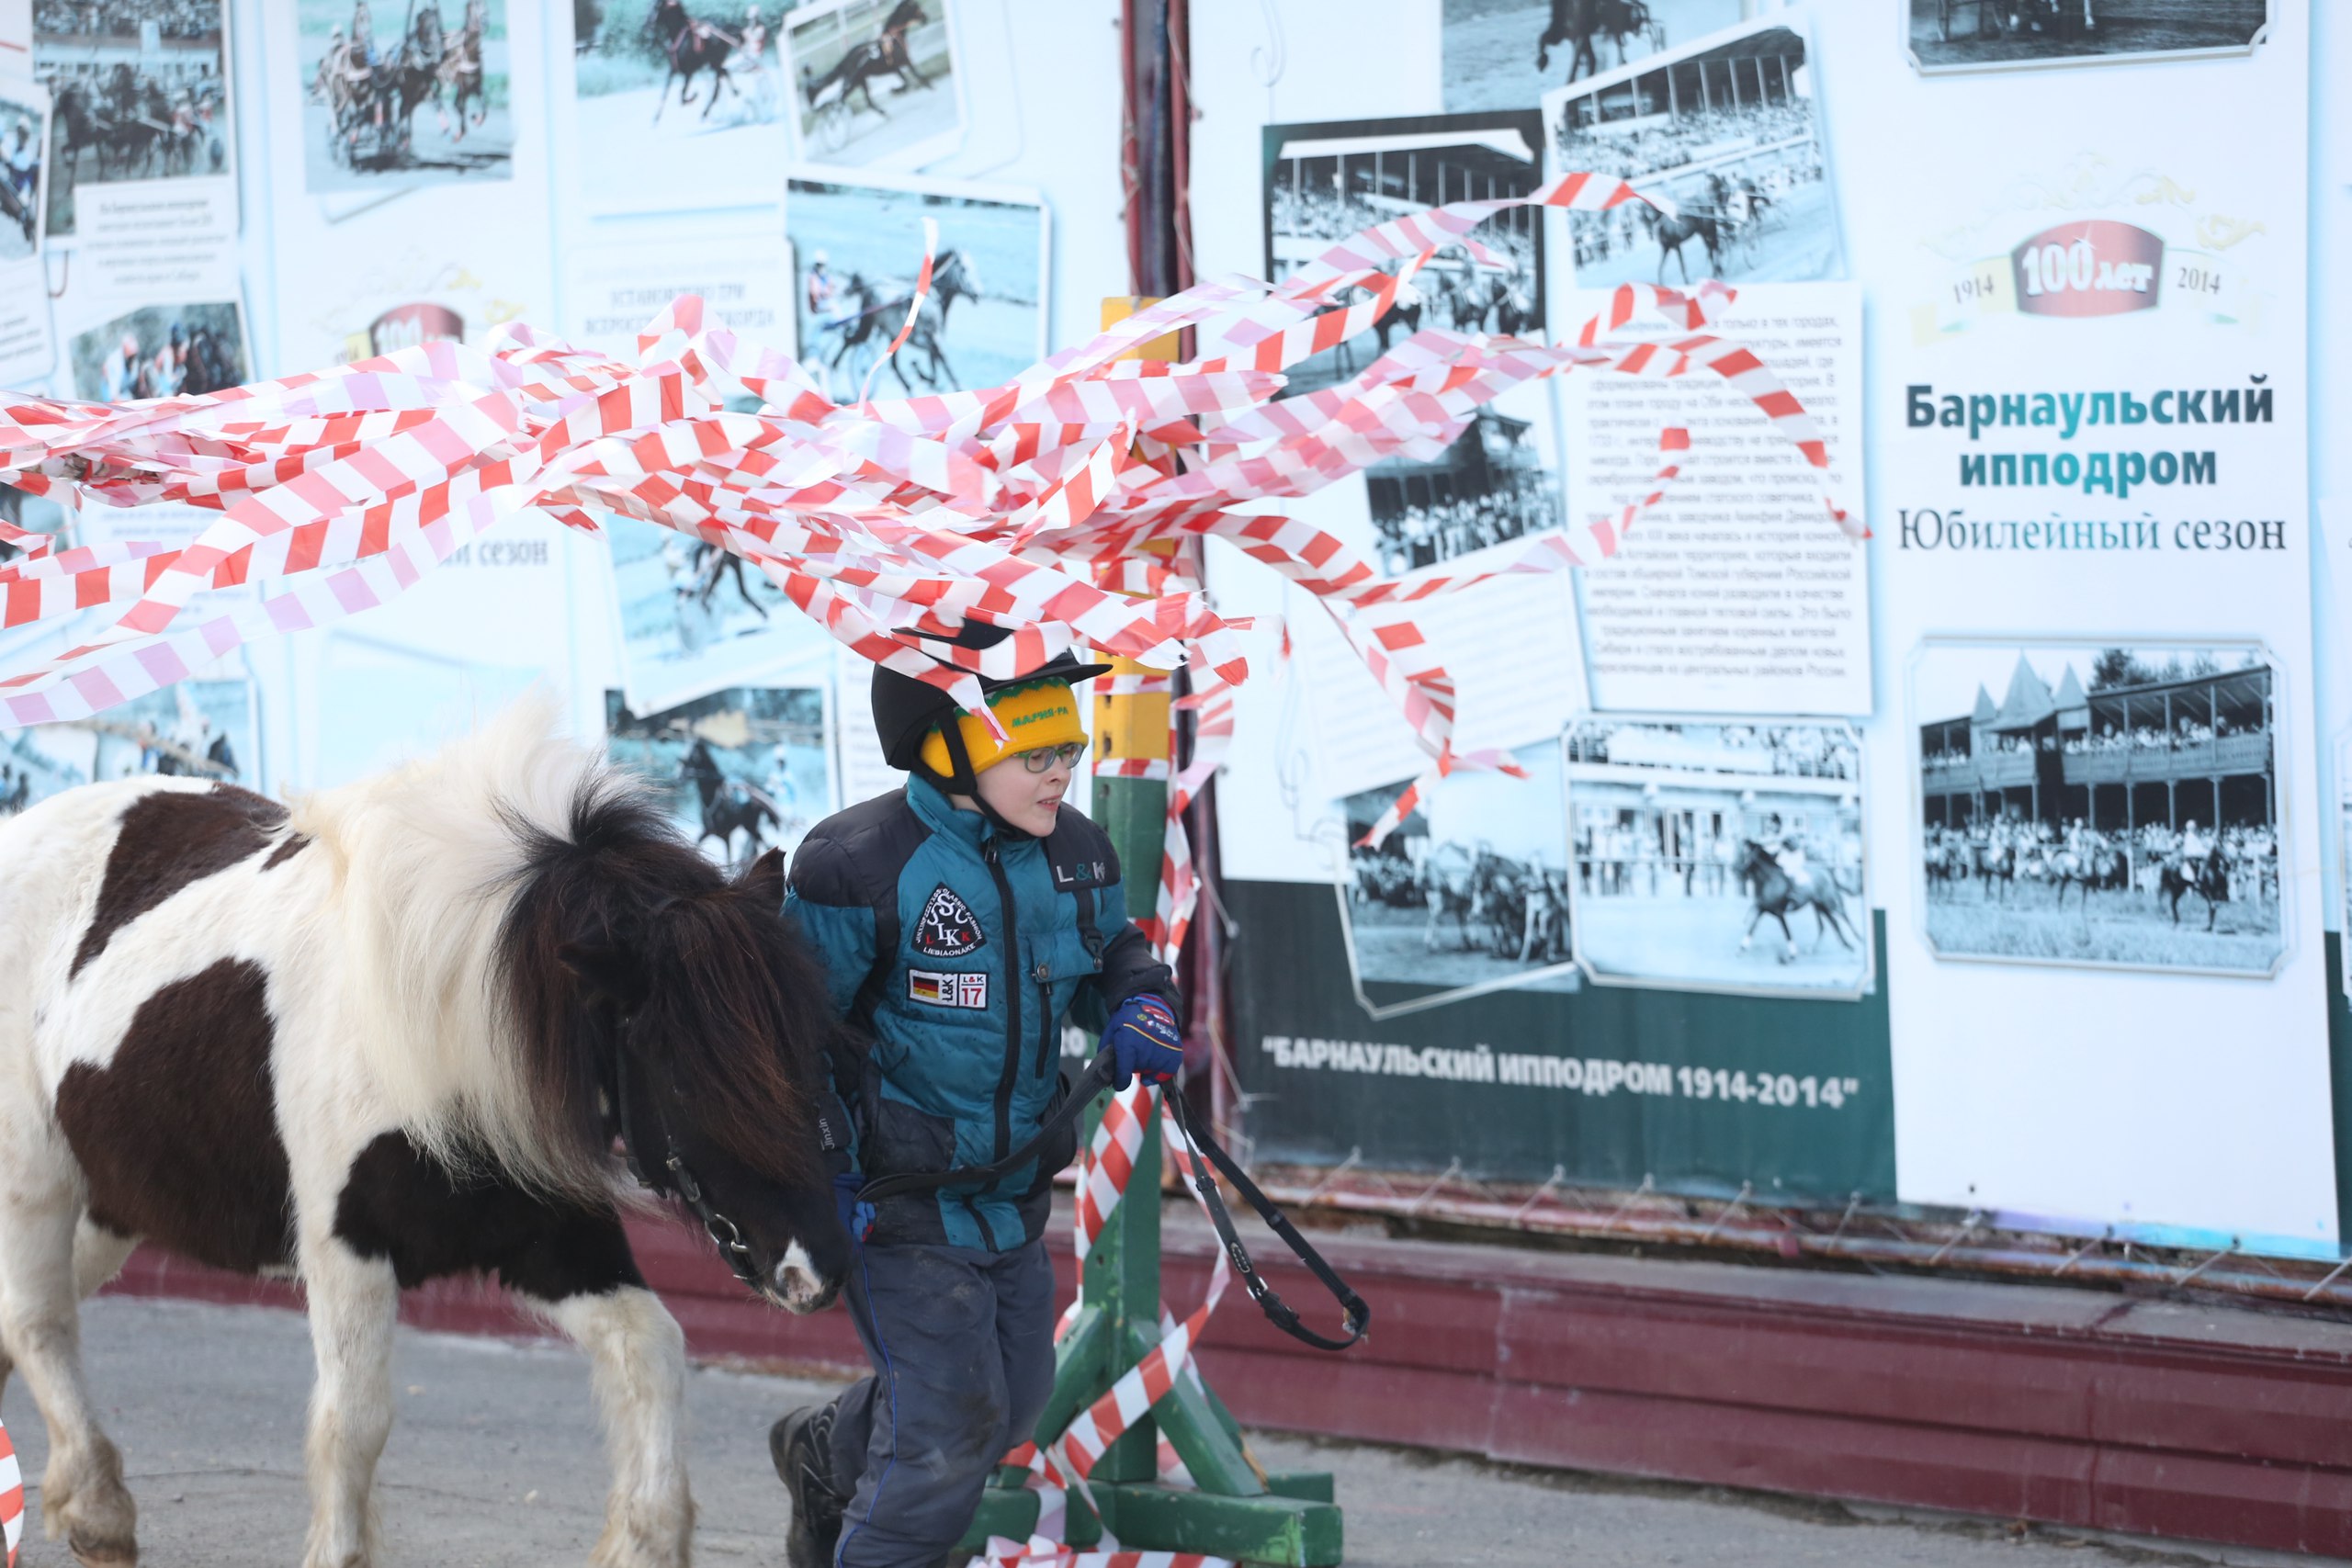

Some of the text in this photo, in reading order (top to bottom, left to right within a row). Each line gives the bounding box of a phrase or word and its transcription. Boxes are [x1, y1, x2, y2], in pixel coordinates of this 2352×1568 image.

[1953, 275, 1995, 304] 1914
[2022, 240, 2154, 297] 100 лет
[2177, 266, 2222, 295] 2014
[1905, 374, 2274, 440] Барнаульский
[1960, 450, 2217, 499] ипподром
[1896, 508, 2288, 550] Юбилейный сезон
[478, 539, 548, 566] сезон
[961, 987, 982, 1006] 17
[1261, 1034, 1860, 1109] "БАРНАУЛЬСКИЙ ИППОДРОМ 1914-2014"
